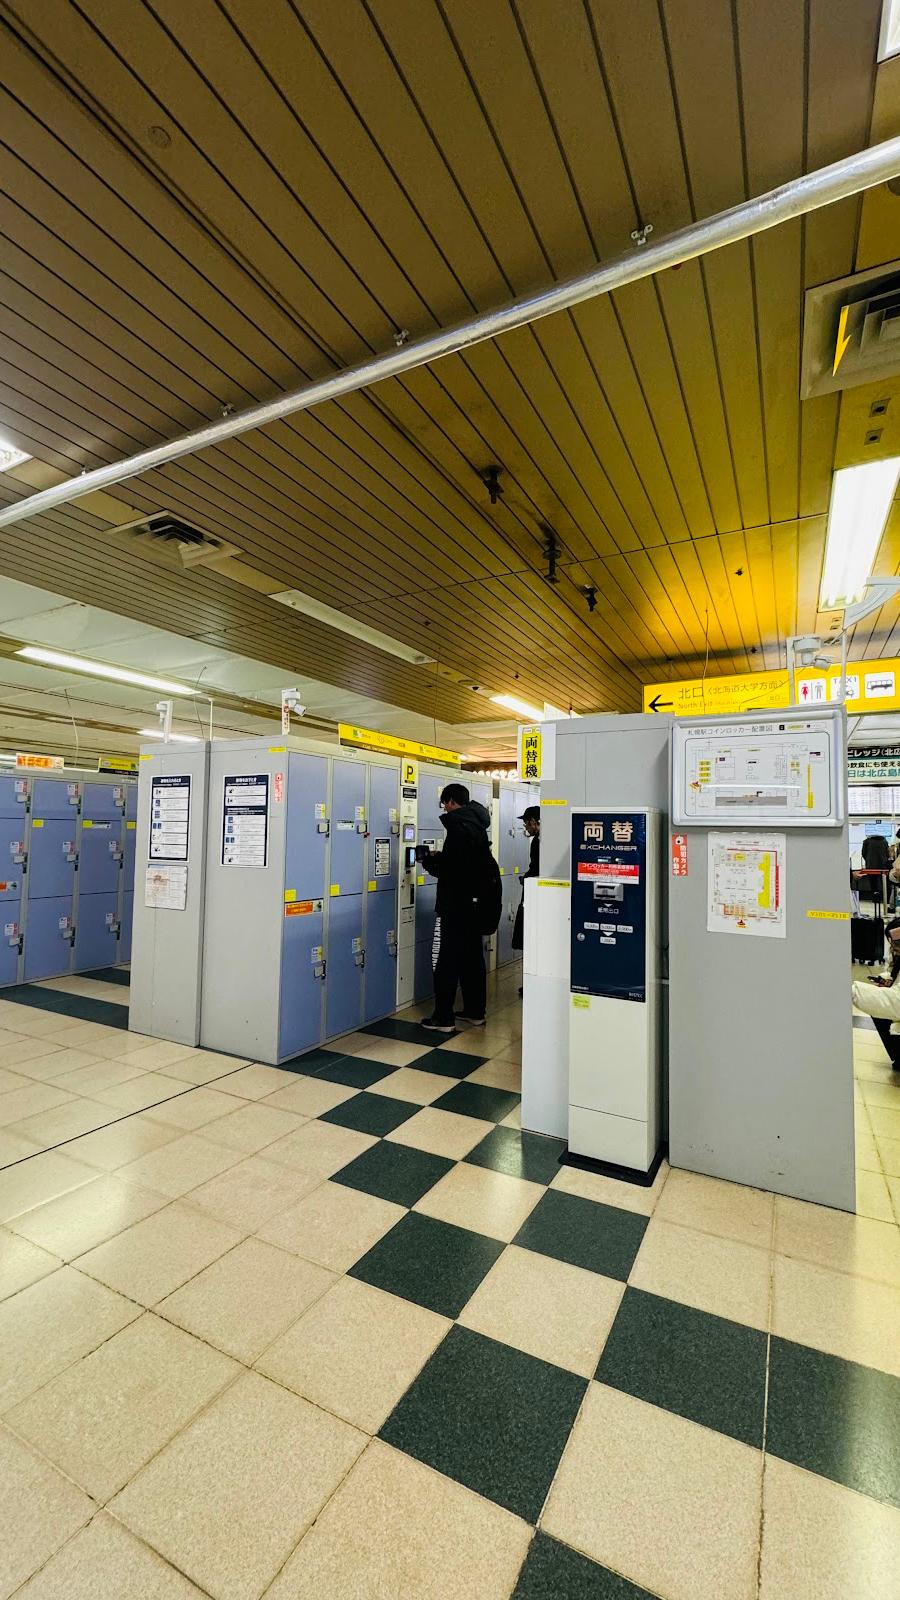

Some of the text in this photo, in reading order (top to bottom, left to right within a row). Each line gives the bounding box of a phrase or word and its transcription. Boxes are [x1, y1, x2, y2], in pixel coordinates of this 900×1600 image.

[833, 676, 857, 684] TXI
[679, 687, 703, 700] 北口
[700, 700, 713, 708] Exit
[688, 725, 773, 736] 札幌駅コインロッカー配置図
[525, 735, 538, 778] 両替機
[407, 765, 414, 780] P
[848, 769, 900, 778] 日は北広島
[583, 821, 634, 842] 両替
[579, 844, 638, 852] EXCHANGER
